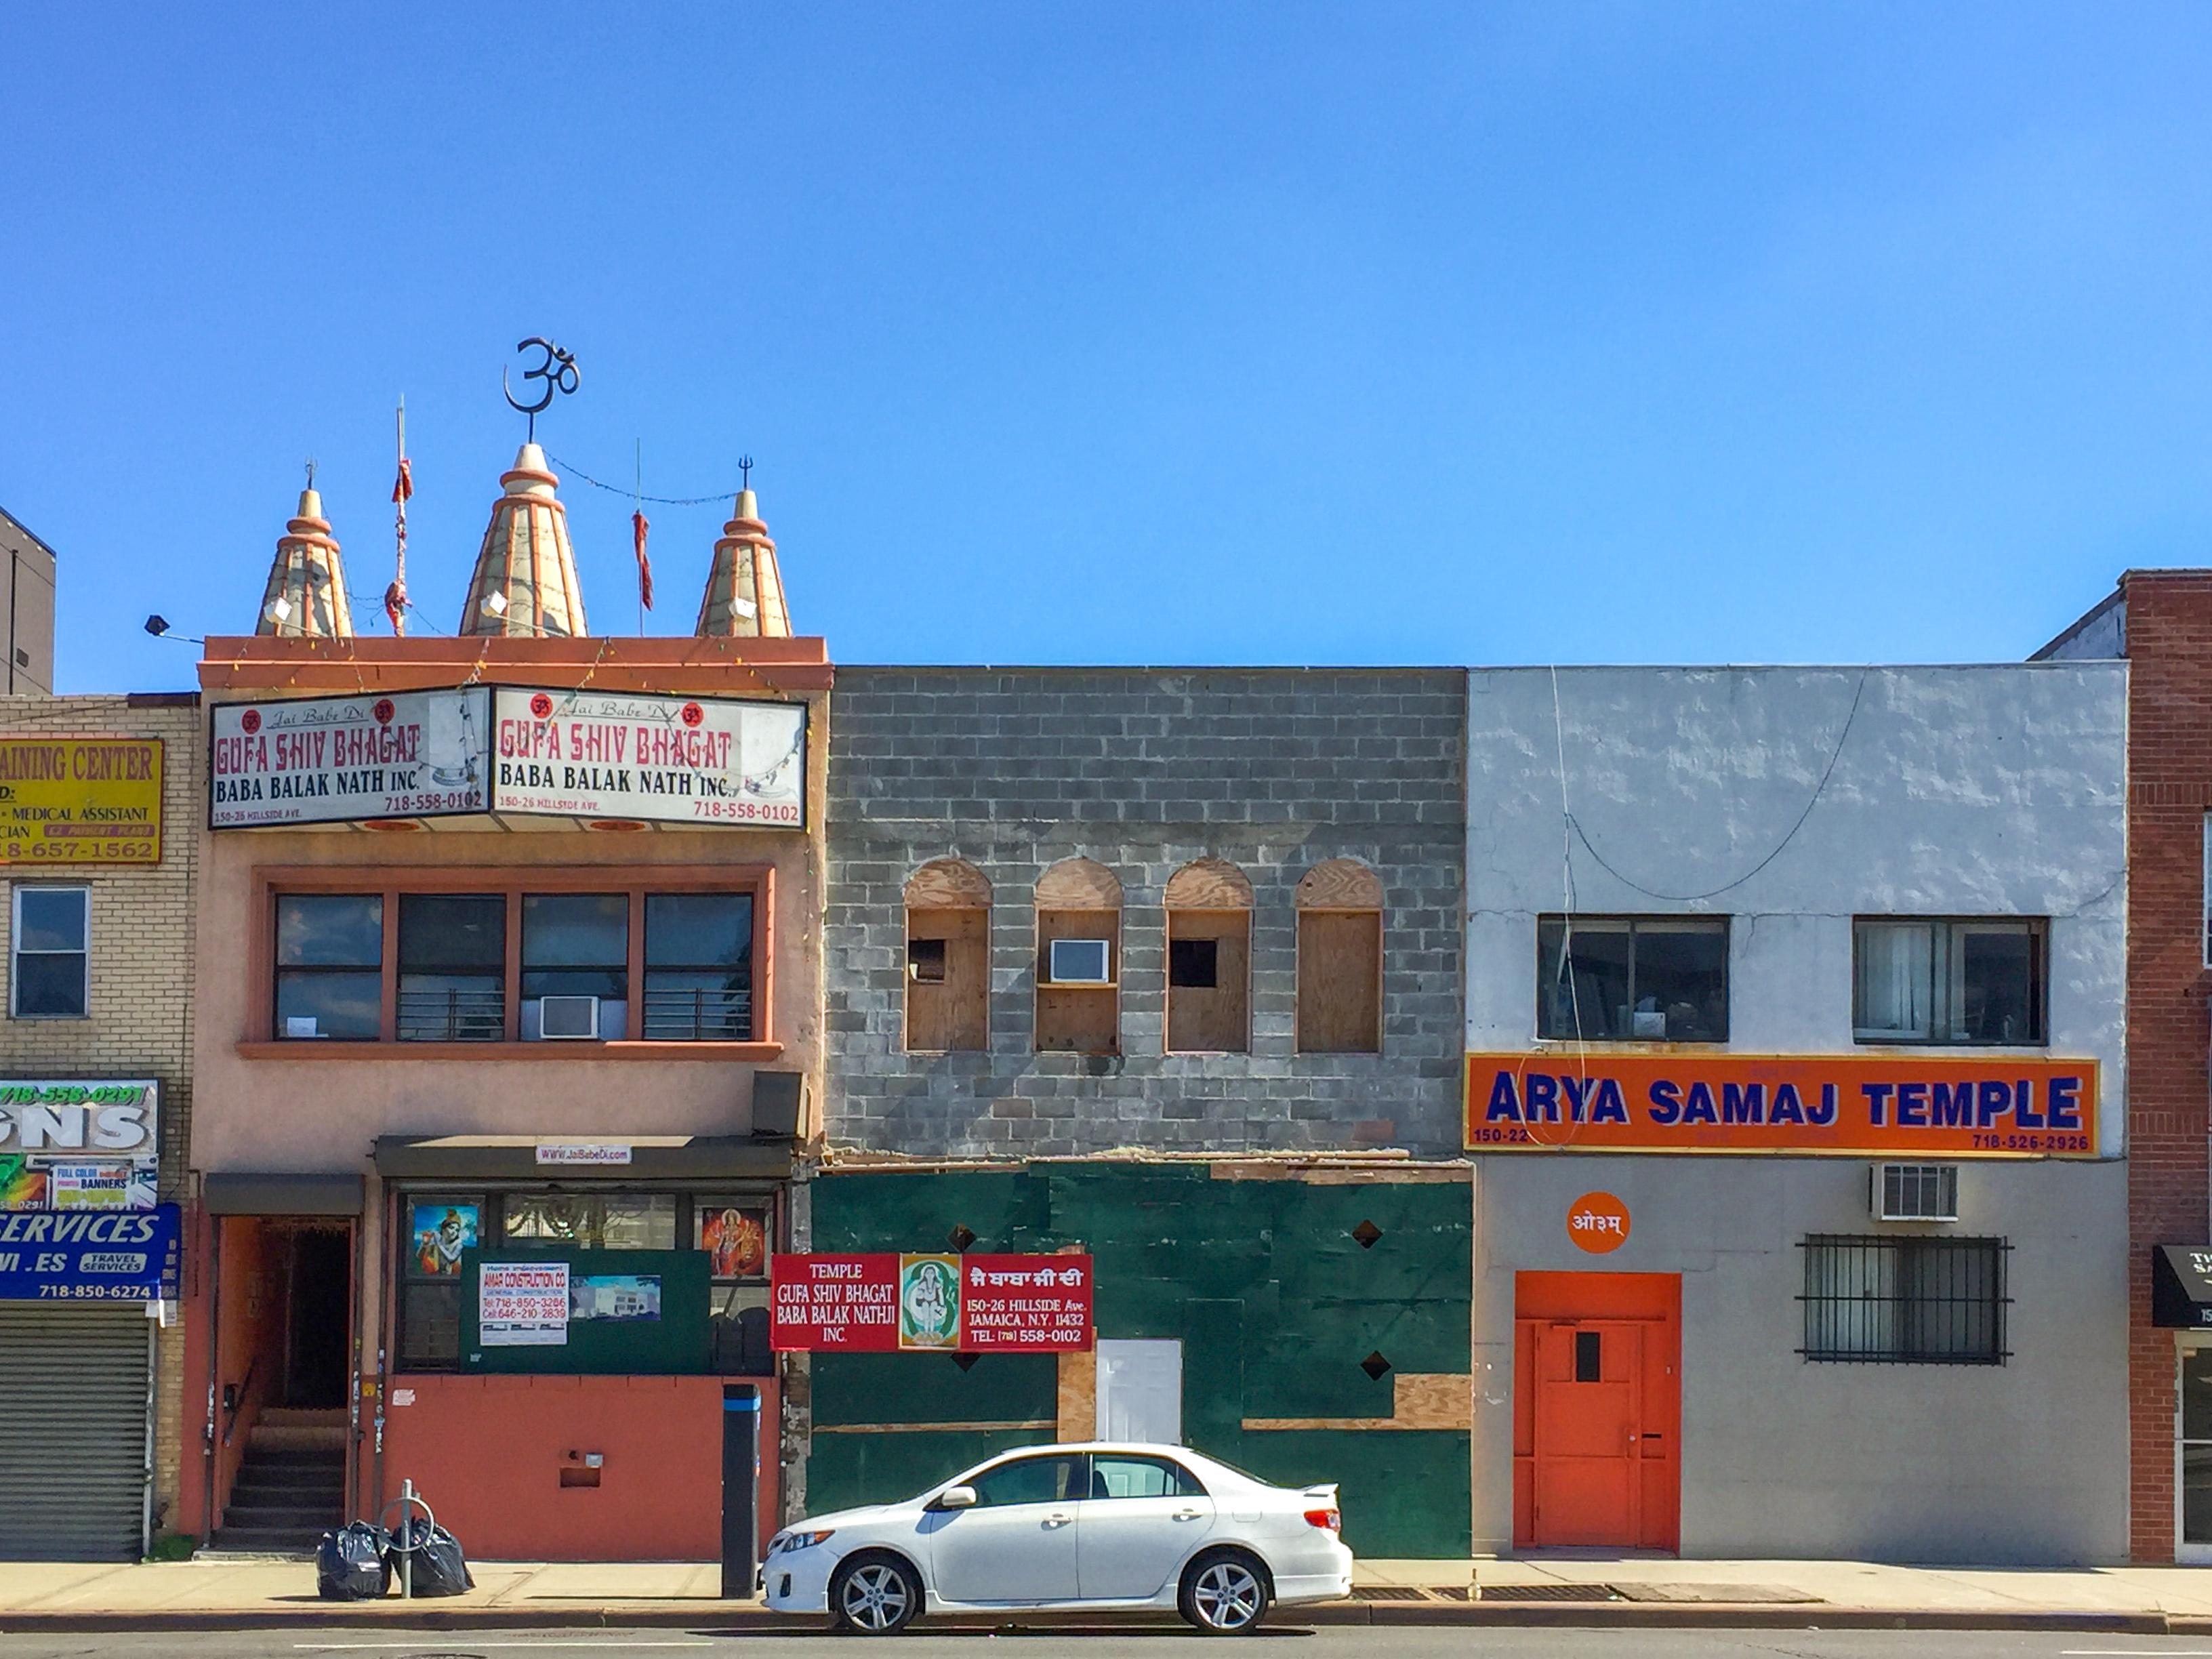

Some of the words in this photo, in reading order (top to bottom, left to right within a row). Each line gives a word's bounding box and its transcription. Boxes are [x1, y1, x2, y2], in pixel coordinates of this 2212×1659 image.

[344, 705, 364, 720] Di
[216, 736, 268, 775] GUFA
[275, 731, 327, 771] SHIV
[333, 724, 421, 769] BHAGAT
[500, 719, 561, 760] GUFA
[571, 723, 628, 764] SHIV
[637, 726, 732, 771] BHAGAT
[73, 747, 153, 781] CENTER
[216, 779, 263, 803] BABA
[270, 773, 330, 800] BALAK
[337, 769, 384, 795] NATH
[390, 770, 420, 791] INC.
[500, 763, 552, 788] BABA
[563, 766, 631, 793] BALAK
[639, 770, 692, 796] NATH
[699, 776, 734, 798] INC.
[385, 791, 483, 813] 718-558-0102
[499, 796, 535, 808] 150-26
[537, 798, 578, 811] HILLSIDE
[12, 807, 73, 821] MEDICAL
[80, 807, 148, 821] ASSISTANT
[215, 811, 245, 822] 150-26
[247, 809, 283, 820] HILLSIDE
[693, 801, 800, 821] 718-558-0102
[1486, 1071, 1632, 1125] ARYA
[1648, 1080, 1839, 1126] SAMAJ
[1862, 1077, 2084, 1129] TEMPLE
[1474, 1129, 1528, 1143] 150-22
[1973, 1134, 2089, 1150] 718-526-2926
[81, 1179, 127, 1189] BANNERS
[0, 1214, 159, 1243] ERVICES
[83, 1263, 141, 1271] SERVICES
[810, 1264, 863, 1279] TEMPLE
[505, 1273, 554, 1287] CONSTRUCTION
[39, 1285, 150, 1298] 718-850-6274
[777, 1284, 809, 1303] GUFA
[813, 1284, 842, 1303] SHIV
[846, 1284, 893, 1303] BHAGAT
[967, 1299, 1005, 1311] 150-26
[1009, 1299, 1061, 1312] HILLSIDE
[777, 1305, 808, 1324] BABA
[811, 1305, 850, 1324] BALAK
[853, 1305, 895, 1324] NATHJI
[969, 1313, 1025, 1327] JAMAICA,
[1028, 1313, 1051, 1326] N.Y.
[1055, 1313, 1084, 1326] 11432
[1020, 1329, 1082, 1343] 558-0102
